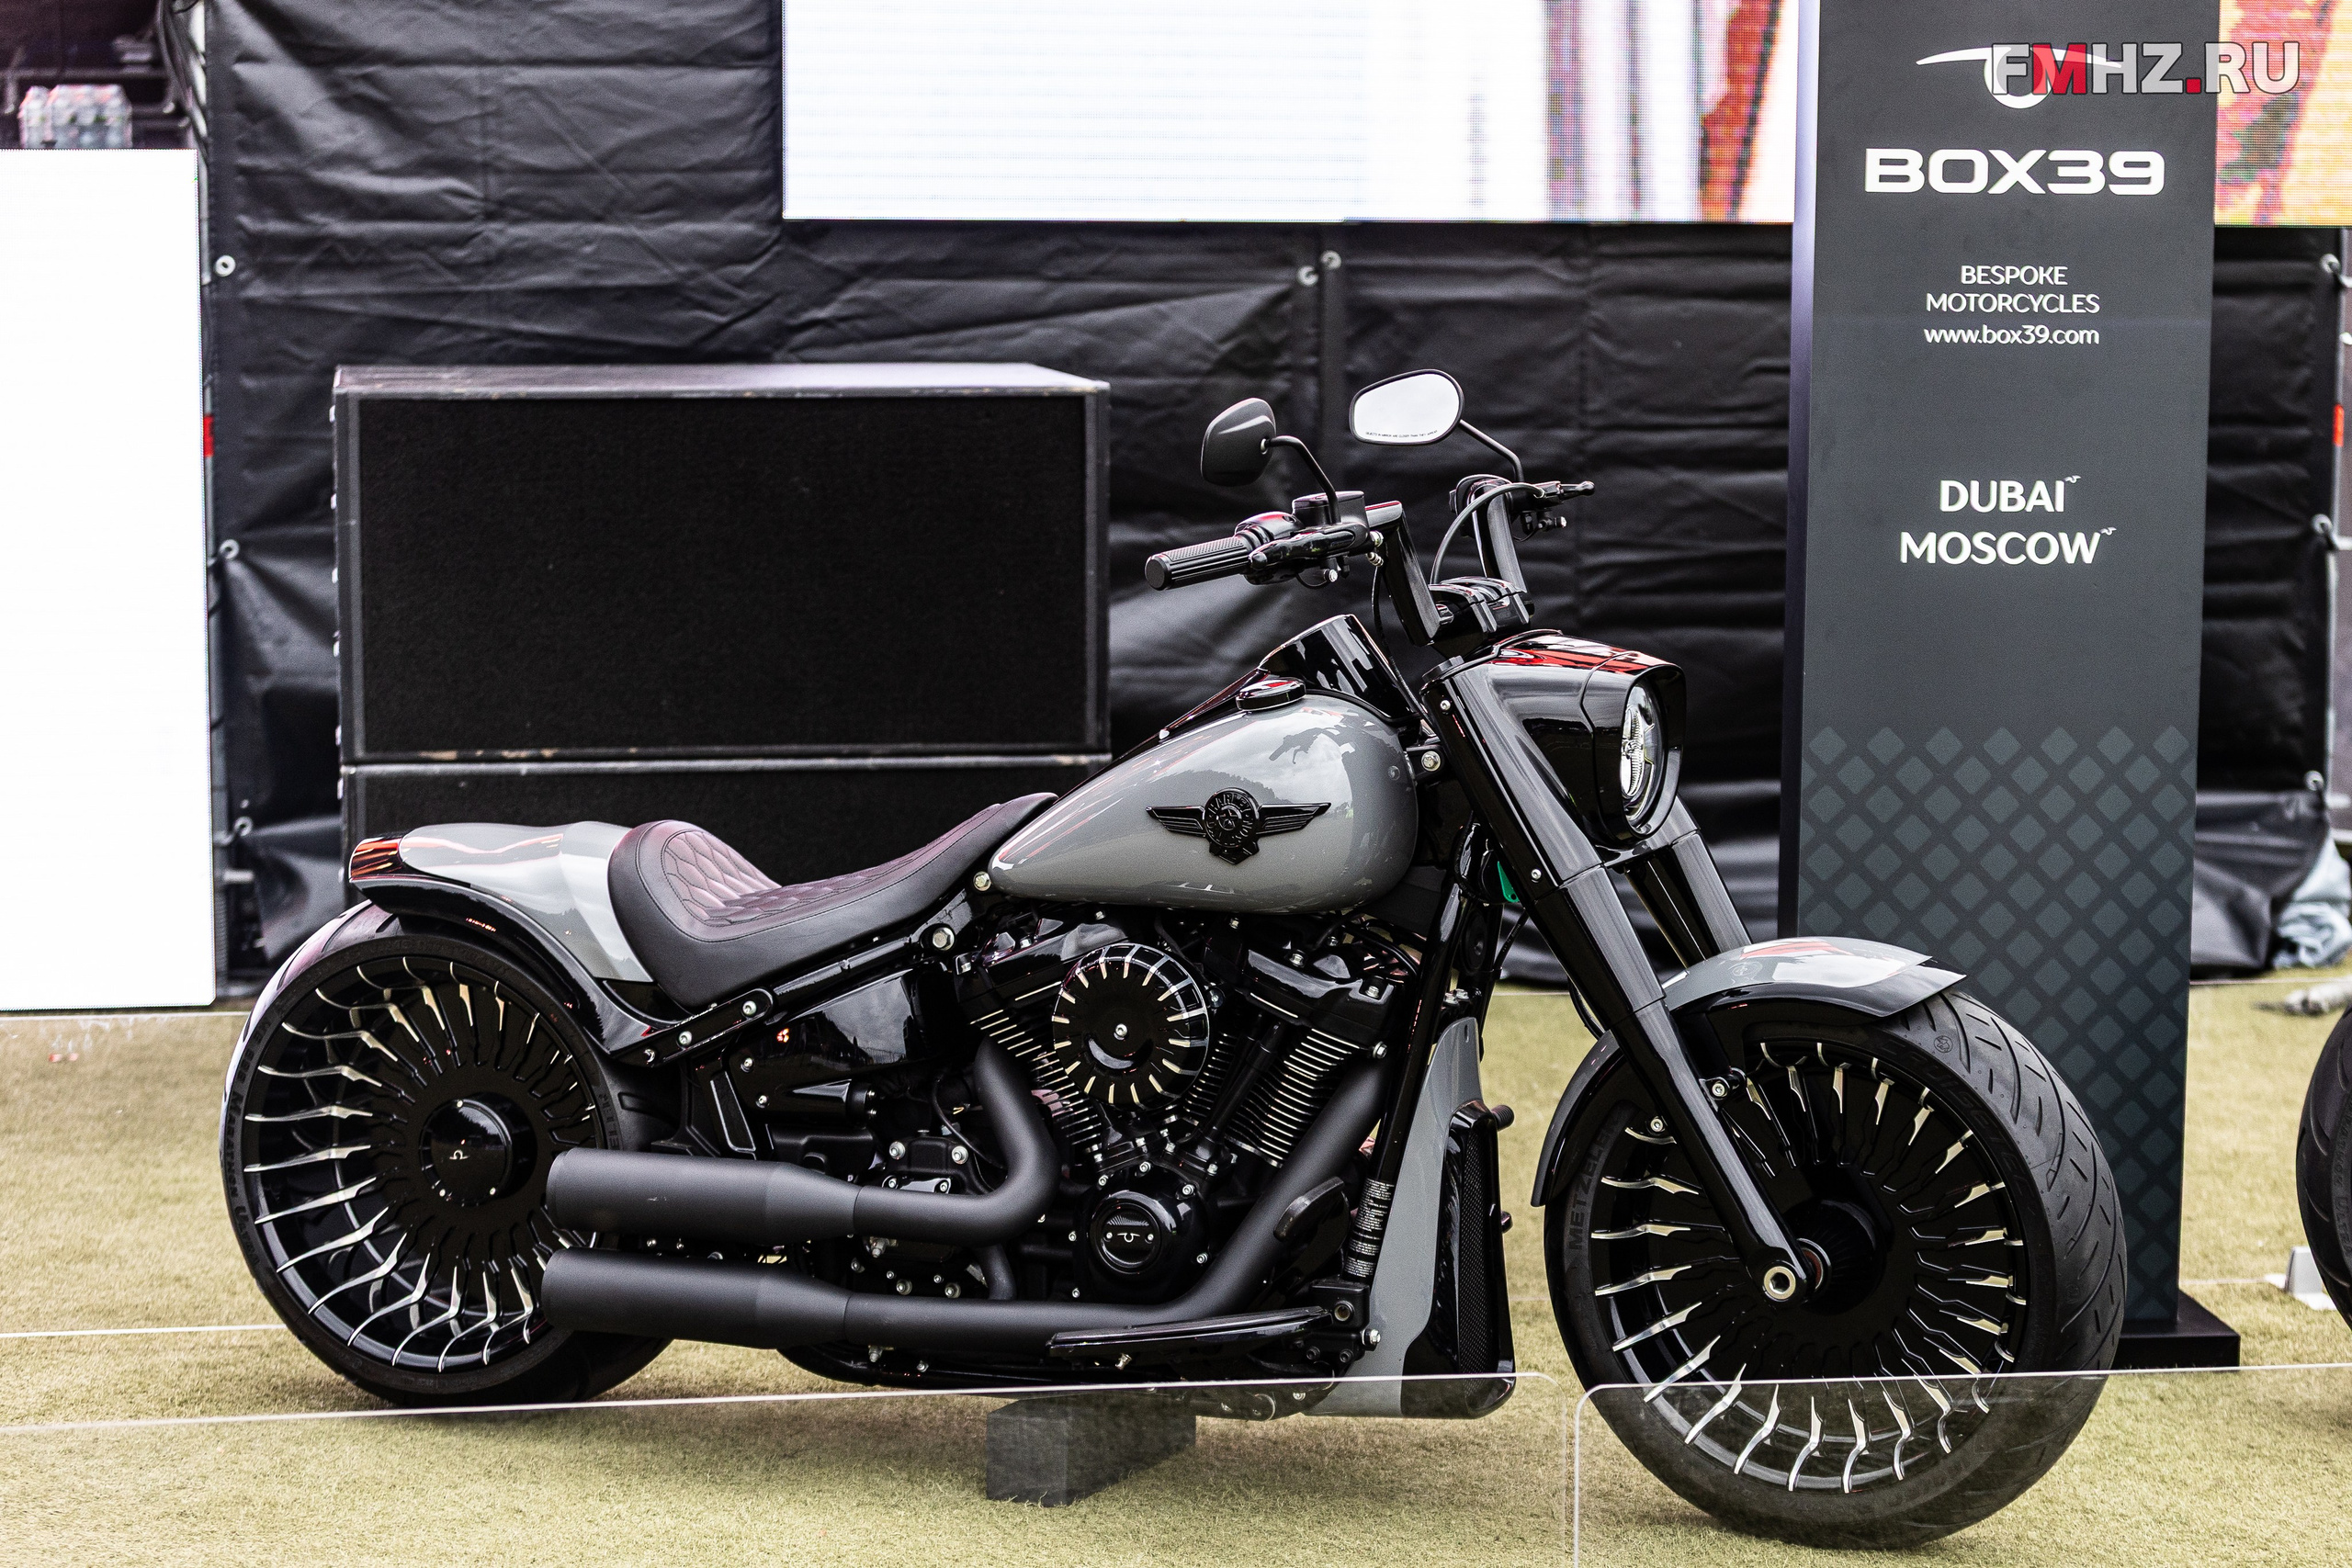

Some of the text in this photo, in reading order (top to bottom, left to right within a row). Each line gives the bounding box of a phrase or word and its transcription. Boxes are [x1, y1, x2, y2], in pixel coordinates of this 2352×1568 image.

[1864, 148, 2165, 196] BOX39
[1961, 265, 2069, 286] BESPOKE
[1926, 293, 2100, 314] MOTORCYCLES
[1923, 323, 2100, 345] www.box39.com
[1939, 479, 2065, 513] DUBAI
[1900, 530, 2101, 565] MOSCOW
[227, 1090, 244, 1198] MARATHON
